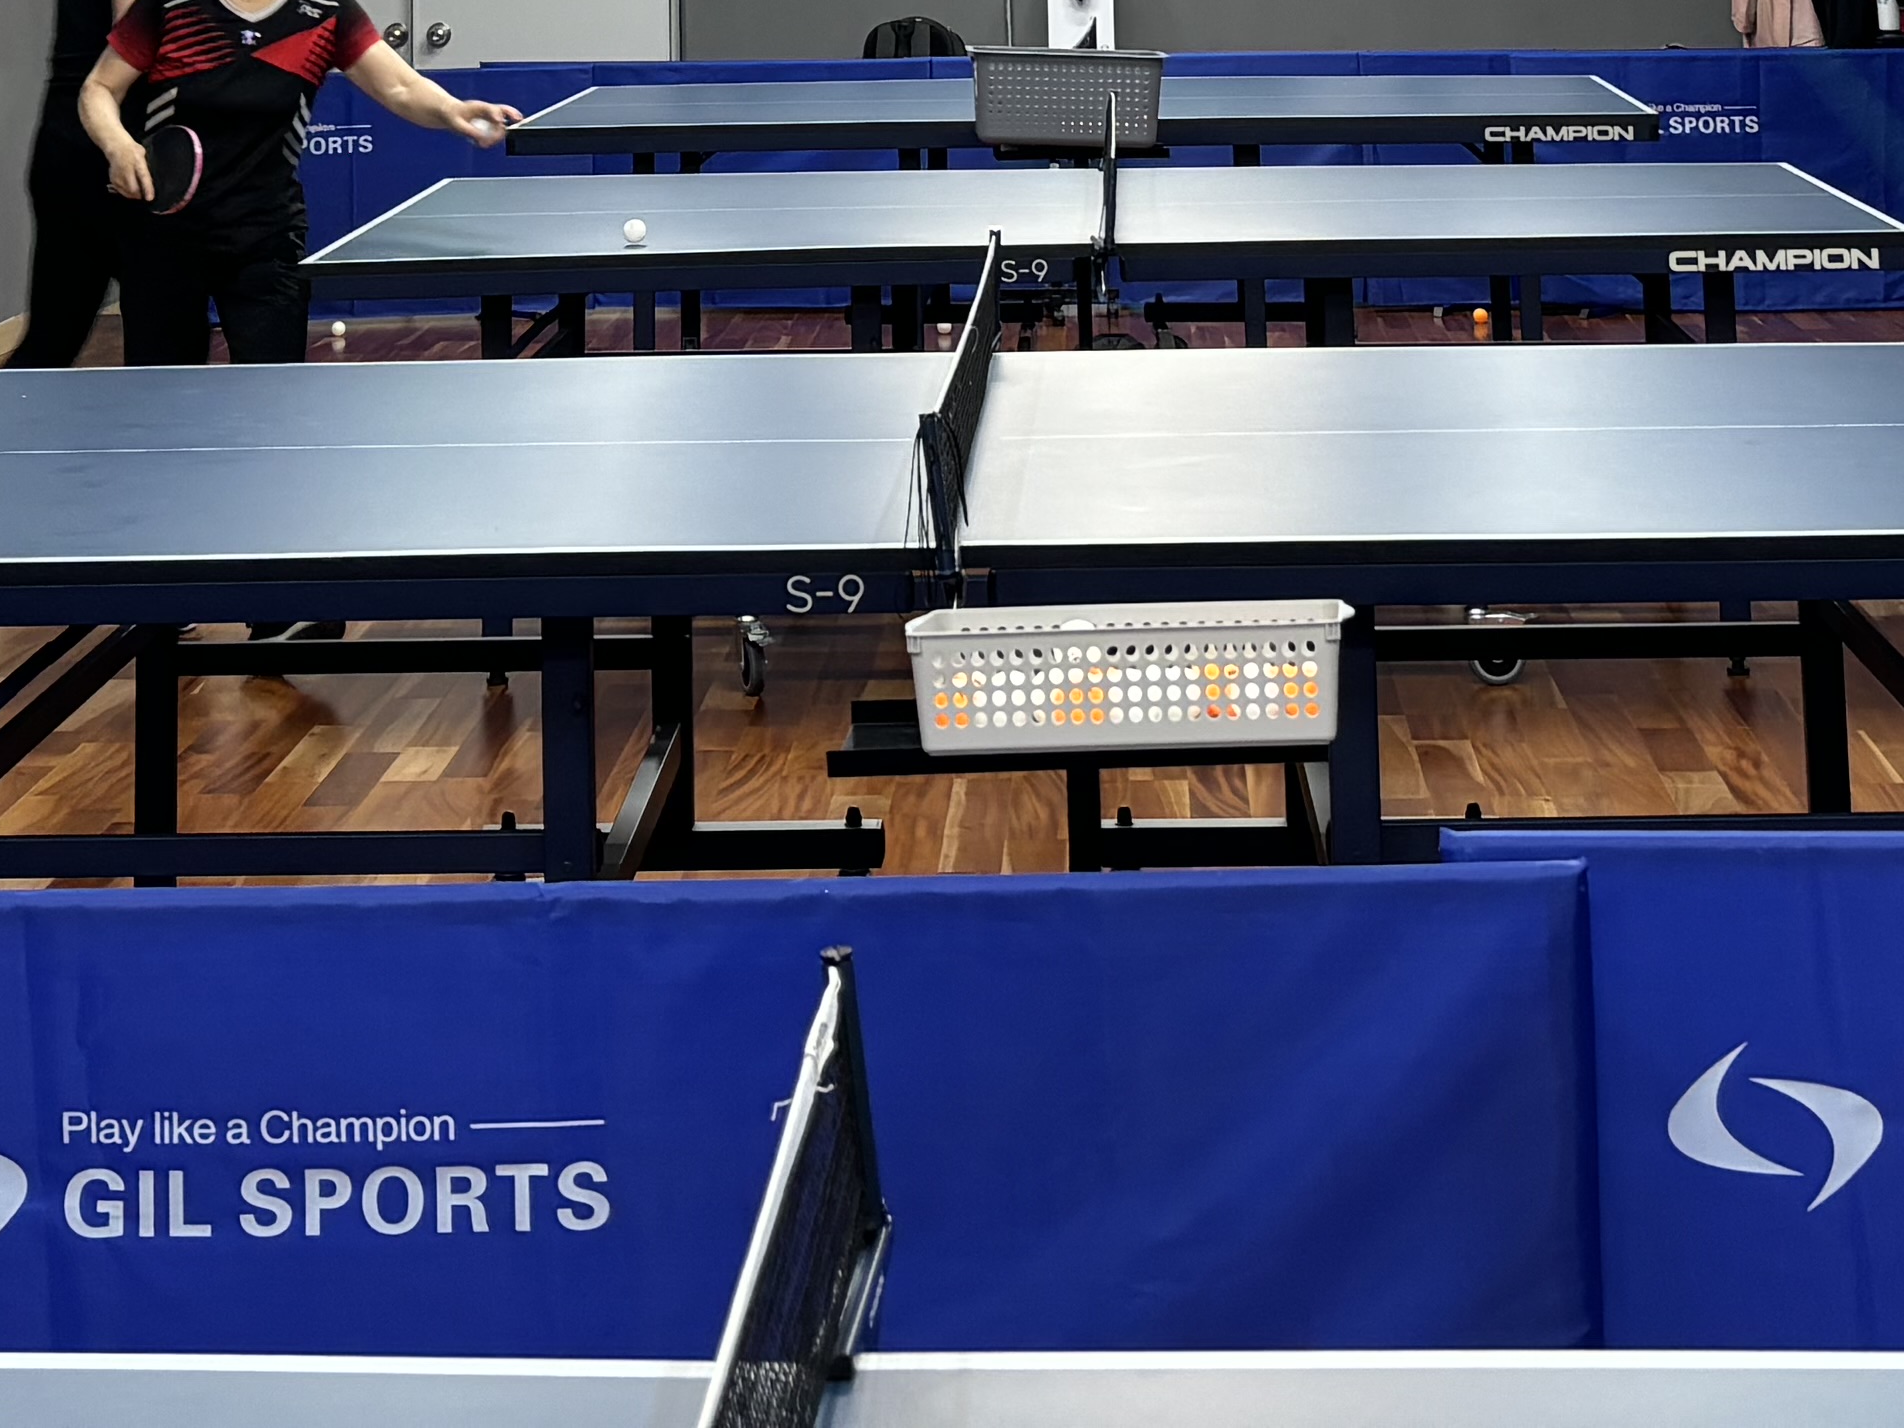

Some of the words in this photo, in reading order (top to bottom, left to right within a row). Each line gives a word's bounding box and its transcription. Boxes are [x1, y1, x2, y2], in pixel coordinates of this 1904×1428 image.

[1673, 102, 1722, 114] Champion
[1484, 125, 1634, 142] CHAMPION
[1668, 116, 1760, 135] SPORTS
[1001, 259, 1048, 283] S-9
[1668, 248, 1880, 272] CHAMPION
[786, 574, 864, 613] S-9
[62, 1110, 144, 1153] Play
[154, 1111, 217, 1145] like
[226, 1118, 251, 1145] a
[260, 1110, 455, 1151] Champion
[63, 1168, 212, 1239] GIL
[239, 1161, 610, 1238] SPORTS
